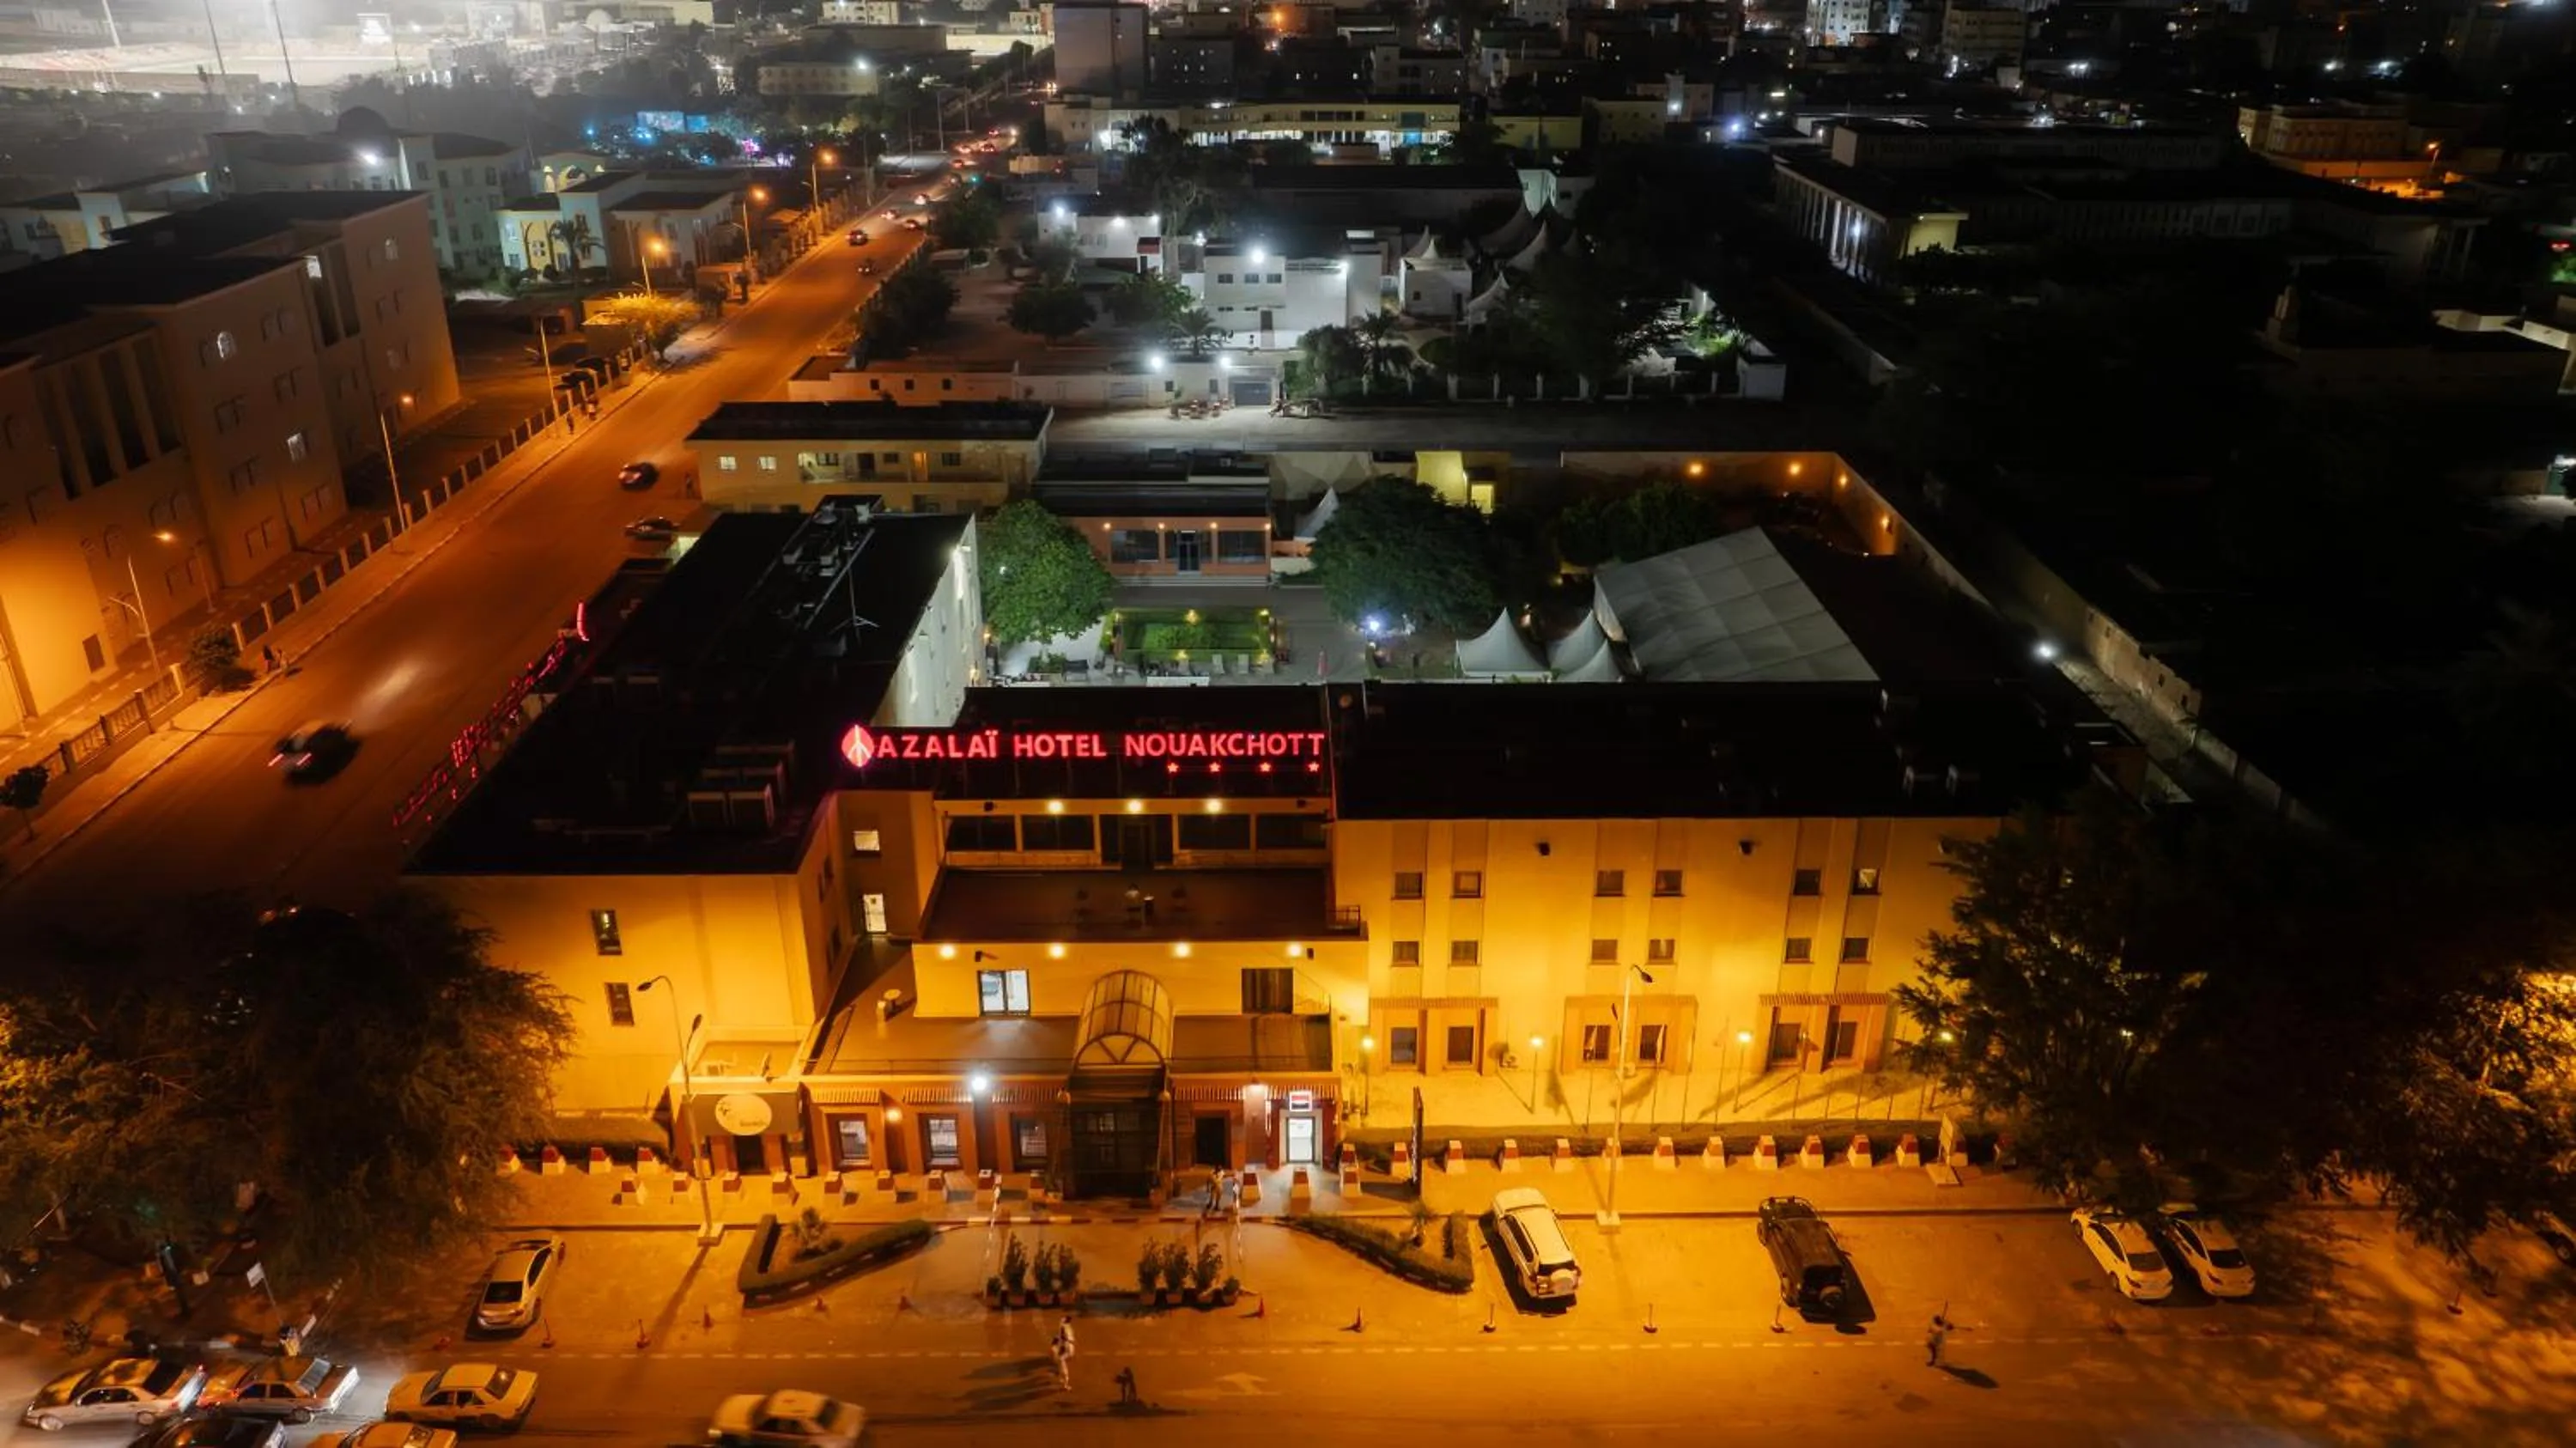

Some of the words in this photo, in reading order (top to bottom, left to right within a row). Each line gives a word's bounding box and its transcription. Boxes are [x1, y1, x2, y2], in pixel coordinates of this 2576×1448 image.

[878, 730, 999, 758] AZALAÏ
[1013, 733, 1108, 758] HOTEL
[1125, 732, 1325, 757] NOUAKCHOTT
